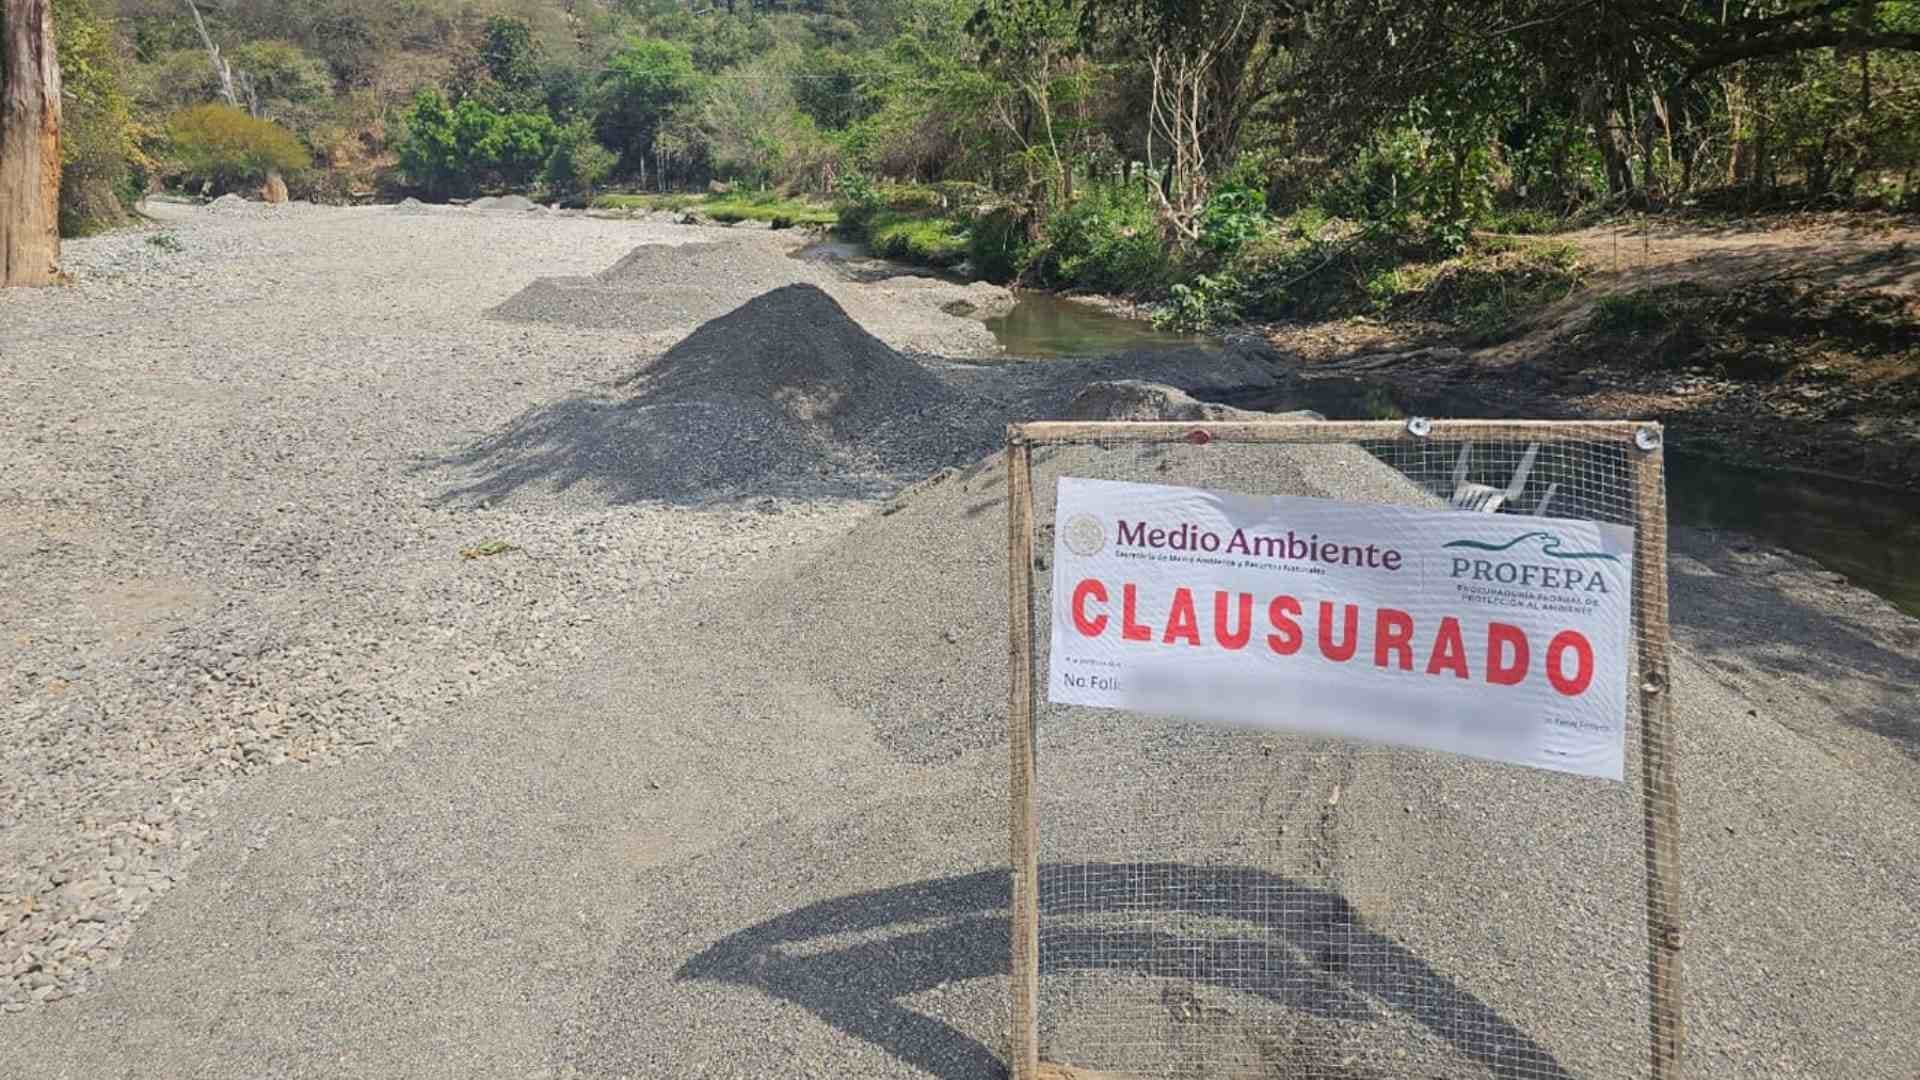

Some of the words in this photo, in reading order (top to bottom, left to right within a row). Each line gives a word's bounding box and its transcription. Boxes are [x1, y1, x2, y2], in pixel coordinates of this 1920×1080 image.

[1115, 519, 1220, 552] Medio
[1225, 527, 1402, 571] Ambiente
[1451, 557, 1610, 593] PROFEPA
[1526, 601, 1539, 611] AL
[1584, 598, 1600, 607] DE
[1071, 578, 1595, 697] CLAUSURADO
